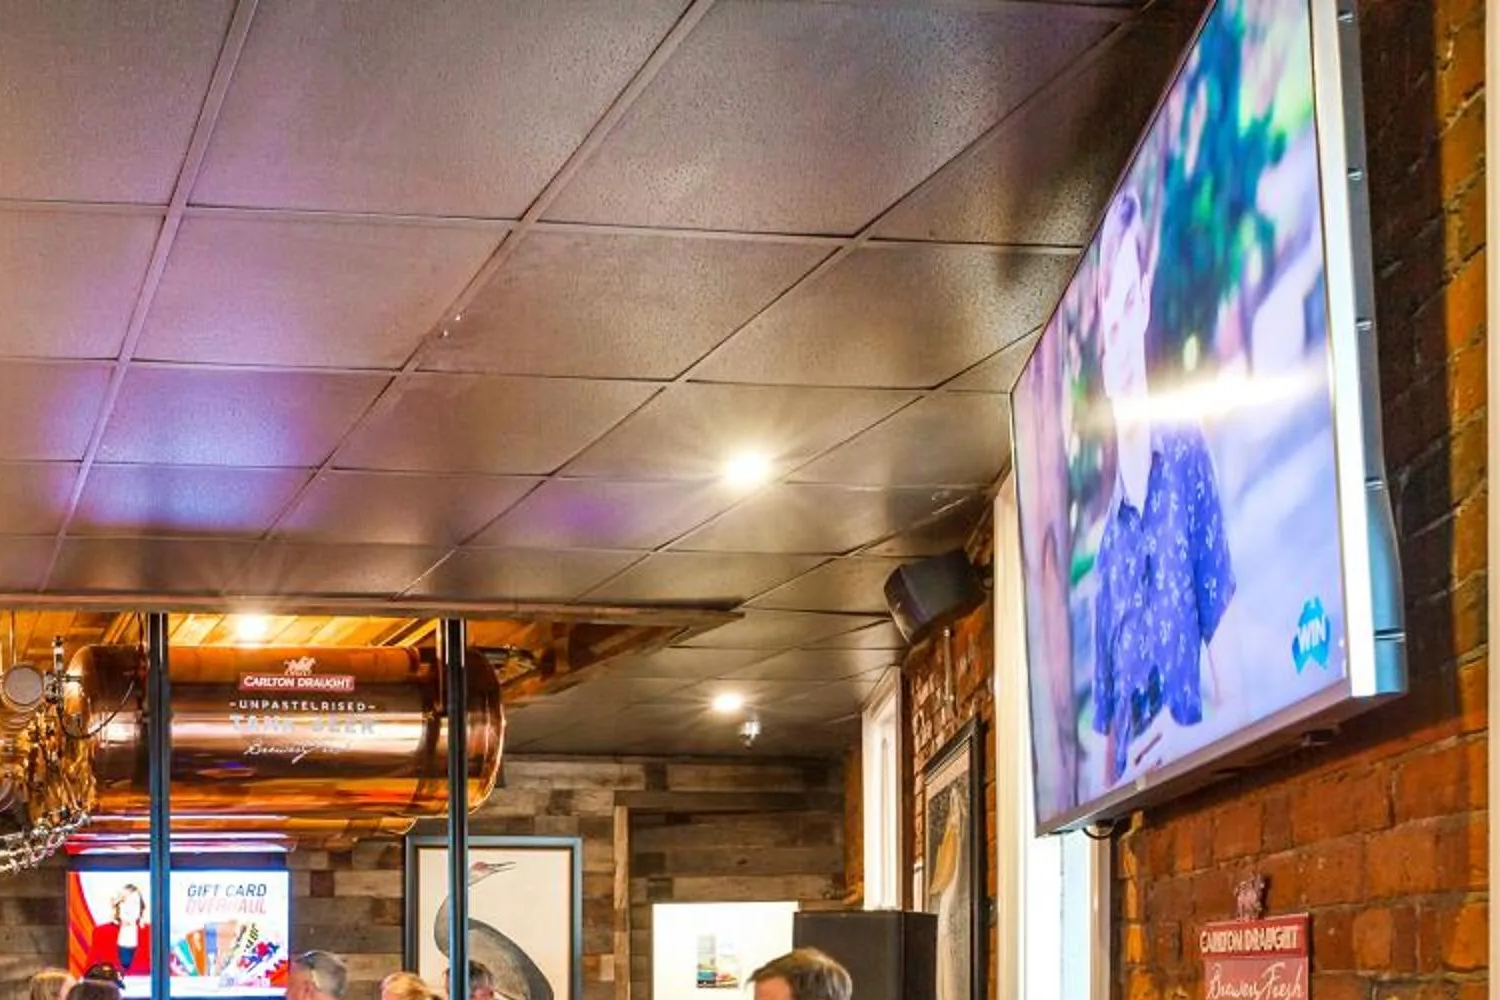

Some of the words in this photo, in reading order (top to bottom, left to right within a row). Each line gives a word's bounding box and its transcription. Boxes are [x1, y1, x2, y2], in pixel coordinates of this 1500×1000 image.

[1297, 615, 1326, 655] WIN
[243, 675, 295, 687] CARLTON
[297, 676, 351, 688] DRAUGHT
[187, 884, 221, 897] GIFT
[225, 883, 267, 897] CARD
[1201, 928, 1245, 953] CARLTON
[1244, 924, 1299, 951] DRAUGHT
